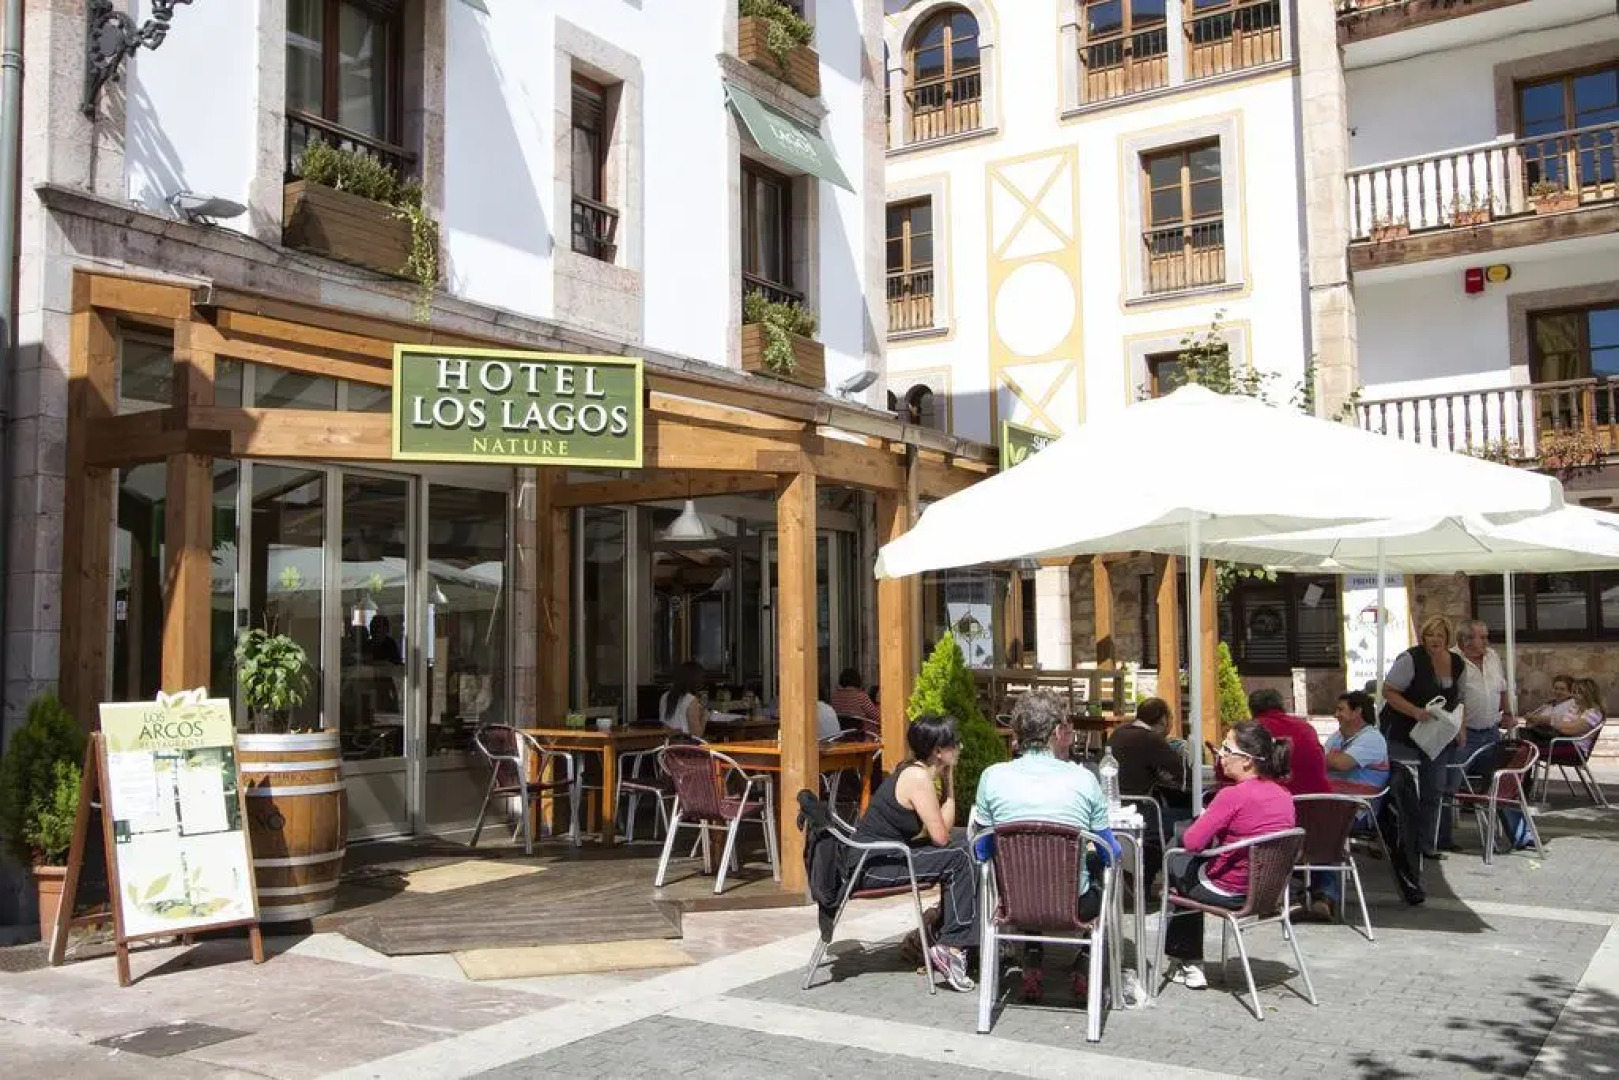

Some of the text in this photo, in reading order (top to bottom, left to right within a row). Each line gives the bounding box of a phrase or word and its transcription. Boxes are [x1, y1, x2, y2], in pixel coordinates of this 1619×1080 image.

[437, 358, 606, 397] HOTEL
[412, 396, 628, 435] LOS LAGOS
[472, 436, 569, 456] NATURE
[143, 711, 165, 723] LOS
[139, 720, 203, 739] ARCOS
